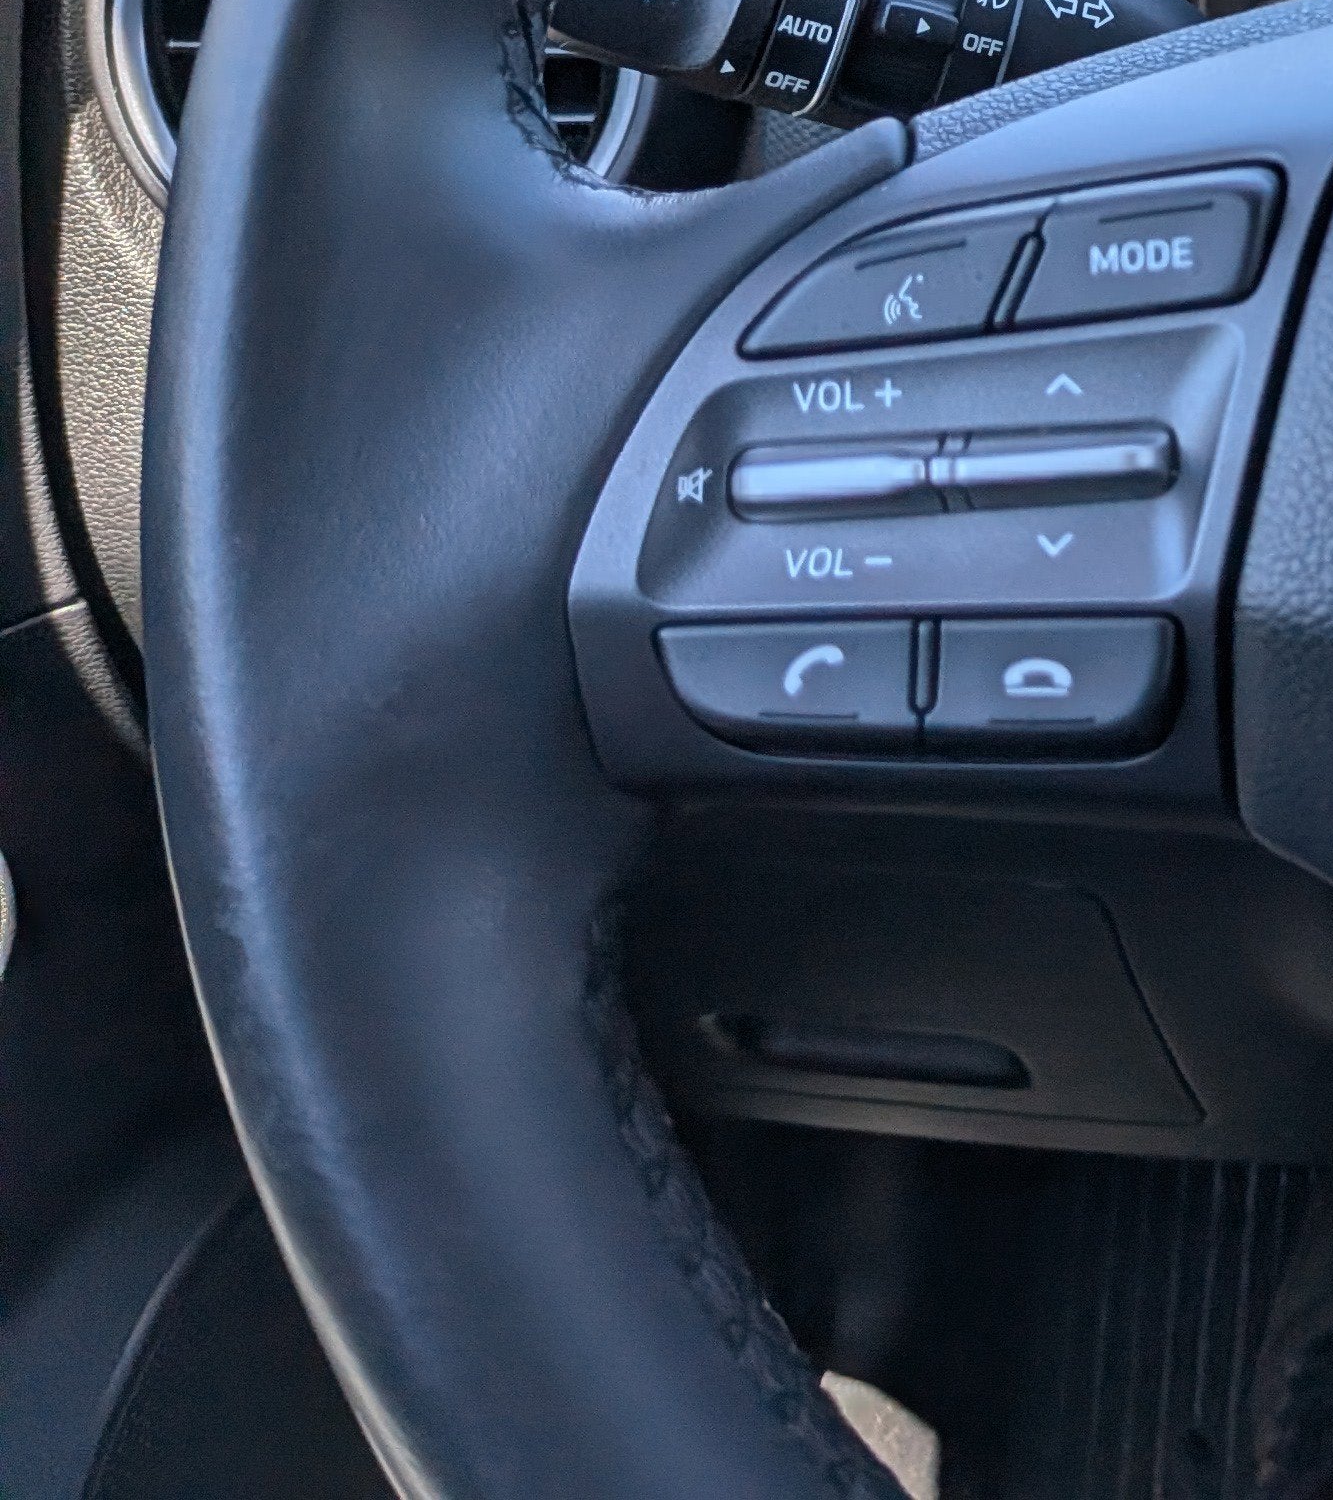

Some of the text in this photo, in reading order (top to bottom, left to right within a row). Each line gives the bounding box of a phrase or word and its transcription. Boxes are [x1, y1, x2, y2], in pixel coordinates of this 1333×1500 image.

[777, 14, 834, 44] AUTO
[962, 32, 1004, 57] OFF
[764, 70, 810, 94] OFF
[1089, 237, 1193, 275] MODE
